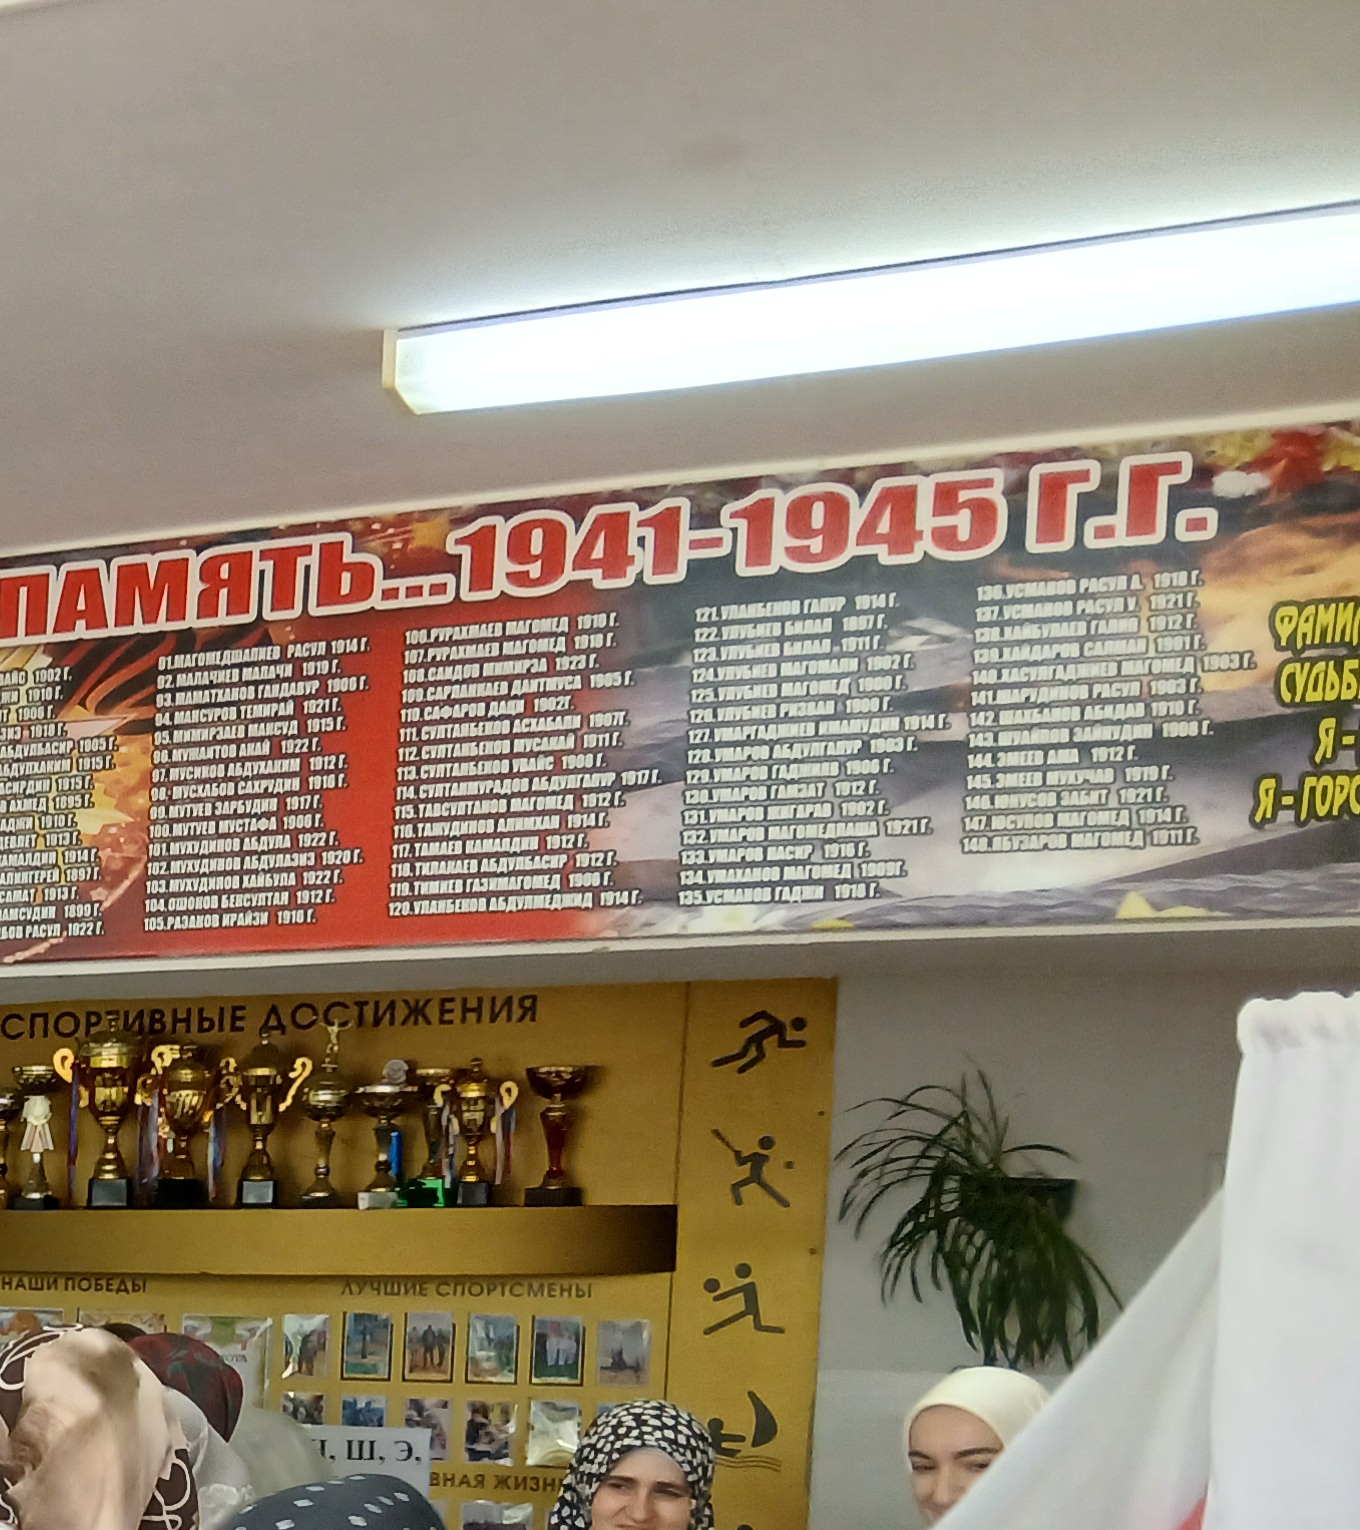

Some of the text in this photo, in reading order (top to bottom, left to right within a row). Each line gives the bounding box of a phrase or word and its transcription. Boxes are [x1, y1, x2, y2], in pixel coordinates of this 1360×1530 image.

[287, 640, 326, 659] РАСУЛ
[1280, 658, 1360, 703] СУДЬБ
[1314, 717, 1337, 765] Я
[1254, 778, 1277, 823] Я
[25, 923, 60, 939] РАСУЛ
[258, 994, 538, 1036] ДОСТИЖЕНИЯ
[0, 1275, 148, 1296] НАШИ ПОБЕДЫ
[340, 1281, 593, 1299] ЛУЧШИЕ СПОРТСМЕНЫ
